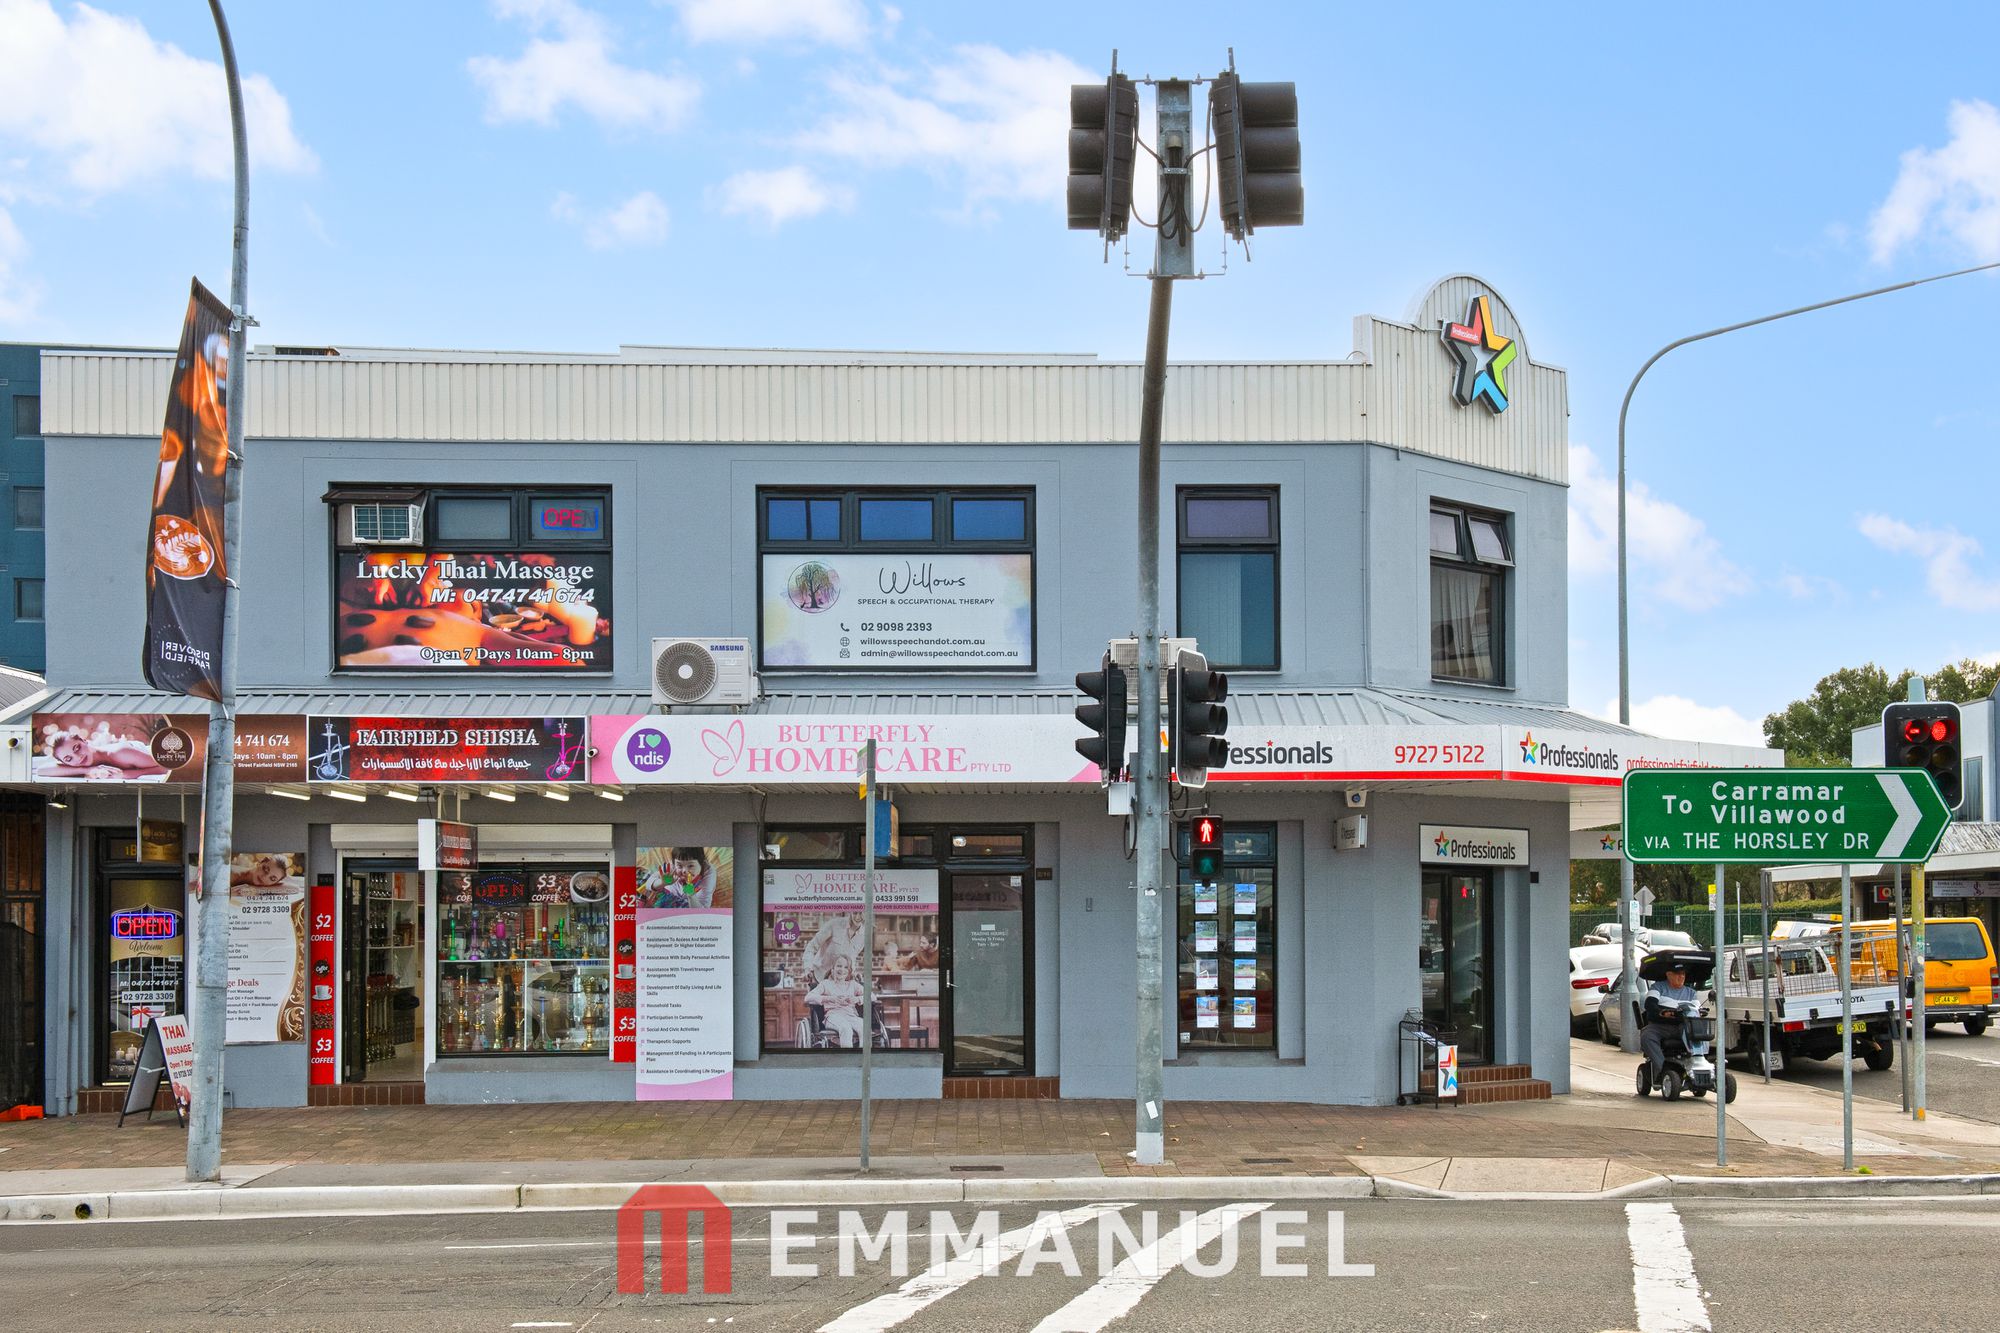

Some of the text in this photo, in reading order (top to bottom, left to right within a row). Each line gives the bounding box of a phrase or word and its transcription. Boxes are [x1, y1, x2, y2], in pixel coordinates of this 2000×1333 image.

[544, 507, 596, 528] OPEN
[357, 559, 594, 584] Lucky Thai Massage
[878, 560, 966, 594] Willows
[430, 588, 594, 602] M: 0474741674
[860, 622, 932, 632] 02 9098 2393
[860, 636, 986, 646] willowsspeechandot.com.au
[420, 648, 460, 660] Open
[464, 648, 472, 660] 7
[476, 648, 512, 661] Days
[562, 648, 594, 661] 8pm
[860, 649, 1018, 659] admin@willowsspeechandot.com.au
[246, 734, 265, 746] 741
[268, 734, 290, 746] 674
[357, 728, 540, 746] FAIRFIELD SHISHA
[638, 734, 645, 748] I
[778, 724, 934, 742] BUTTERFLY
[634, 751, 664, 766] ndis
[746, 747, 1011, 772] HOME CARE PTY LTD
[1228, 741, 1485, 765] essionals 9727 5122
[1540, 743, 1618, 771] Professionals
[1662, 781, 1844, 814] To Carramar
[1711, 805, 1846, 824] Villawood
[1644, 832, 1869, 849] VIA THE HORSLEY DR
[1451, 839, 1516, 861] Professionals
[537, 874, 556, 890] $3
[814, 883, 856, 893] HOME
[619, 892, 636, 909] $2
[118, 917, 171, 935] OPEN
[316, 913, 331, 930] $2
[128, 941, 163, 953] Welcome
[1835, 996, 1865, 1004] TOOTA
[162, 1024, 185, 1039] THAI
[619, 1016, 635, 1031] $3
[165, 1044, 192, 1056] MASSAGE
[316, 1038, 332, 1054] $3
